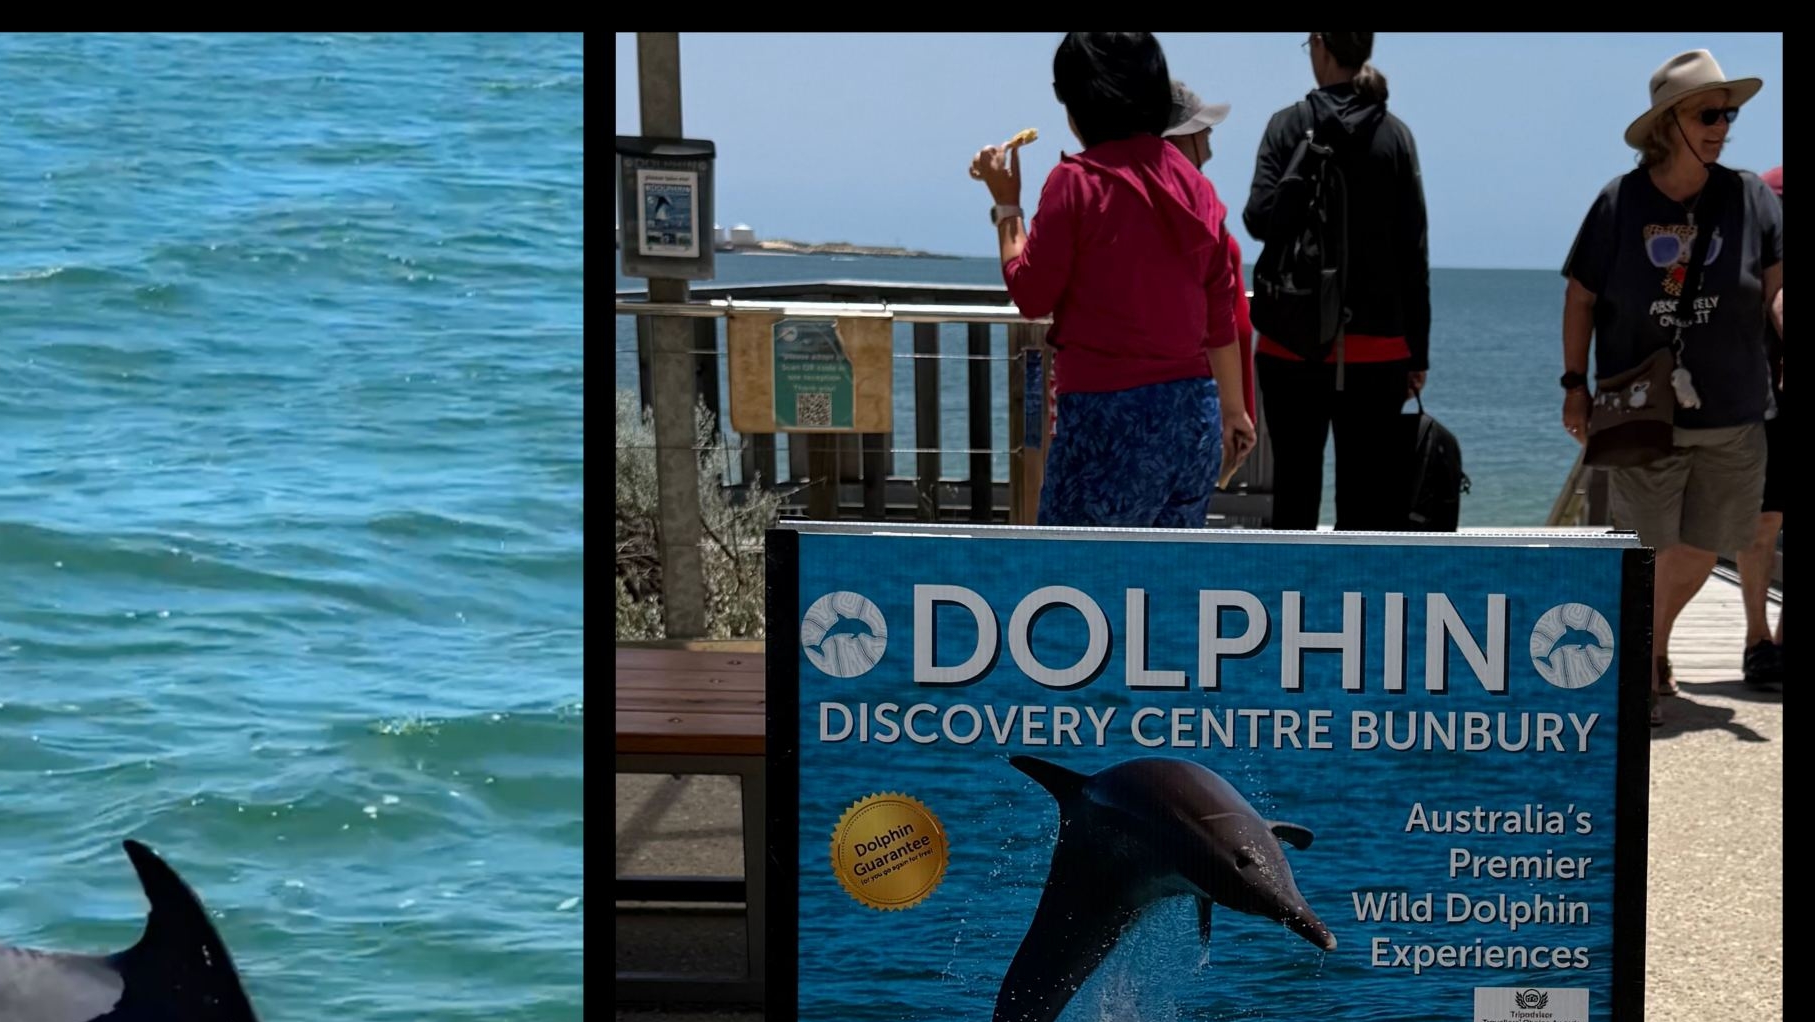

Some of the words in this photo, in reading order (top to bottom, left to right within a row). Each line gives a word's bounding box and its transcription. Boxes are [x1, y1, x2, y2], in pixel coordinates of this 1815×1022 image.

[1649, 295, 1720, 315] ABSTELY
[1695, 310, 1711, 324] IT
[914, 584, 1506, 690] DOLPHIN
[820, 702, 1116, 745] DISCOVERY
[1131, 707, 1332, 748] CENTRE
[1352, 711, 1598, 751] BUNBURY
[854, 824, 914, 857] Dolphin
[854, 836, 931, 876] Guarantee
[871, 873, 883, 881] you
[884, 868, 891, 876] go
[892, 860, 908, 871] again
[909, 855, 918, 864] for
[1450, 848, 1591, 878] Premier
[1352, 892, 1431, 921] Wild
[1447, 893, 1588, 930] Dolphin
[1372, 937, 1588, 974] Experiences
[1510, 1011, 1553, 1019] Tripadvisor
